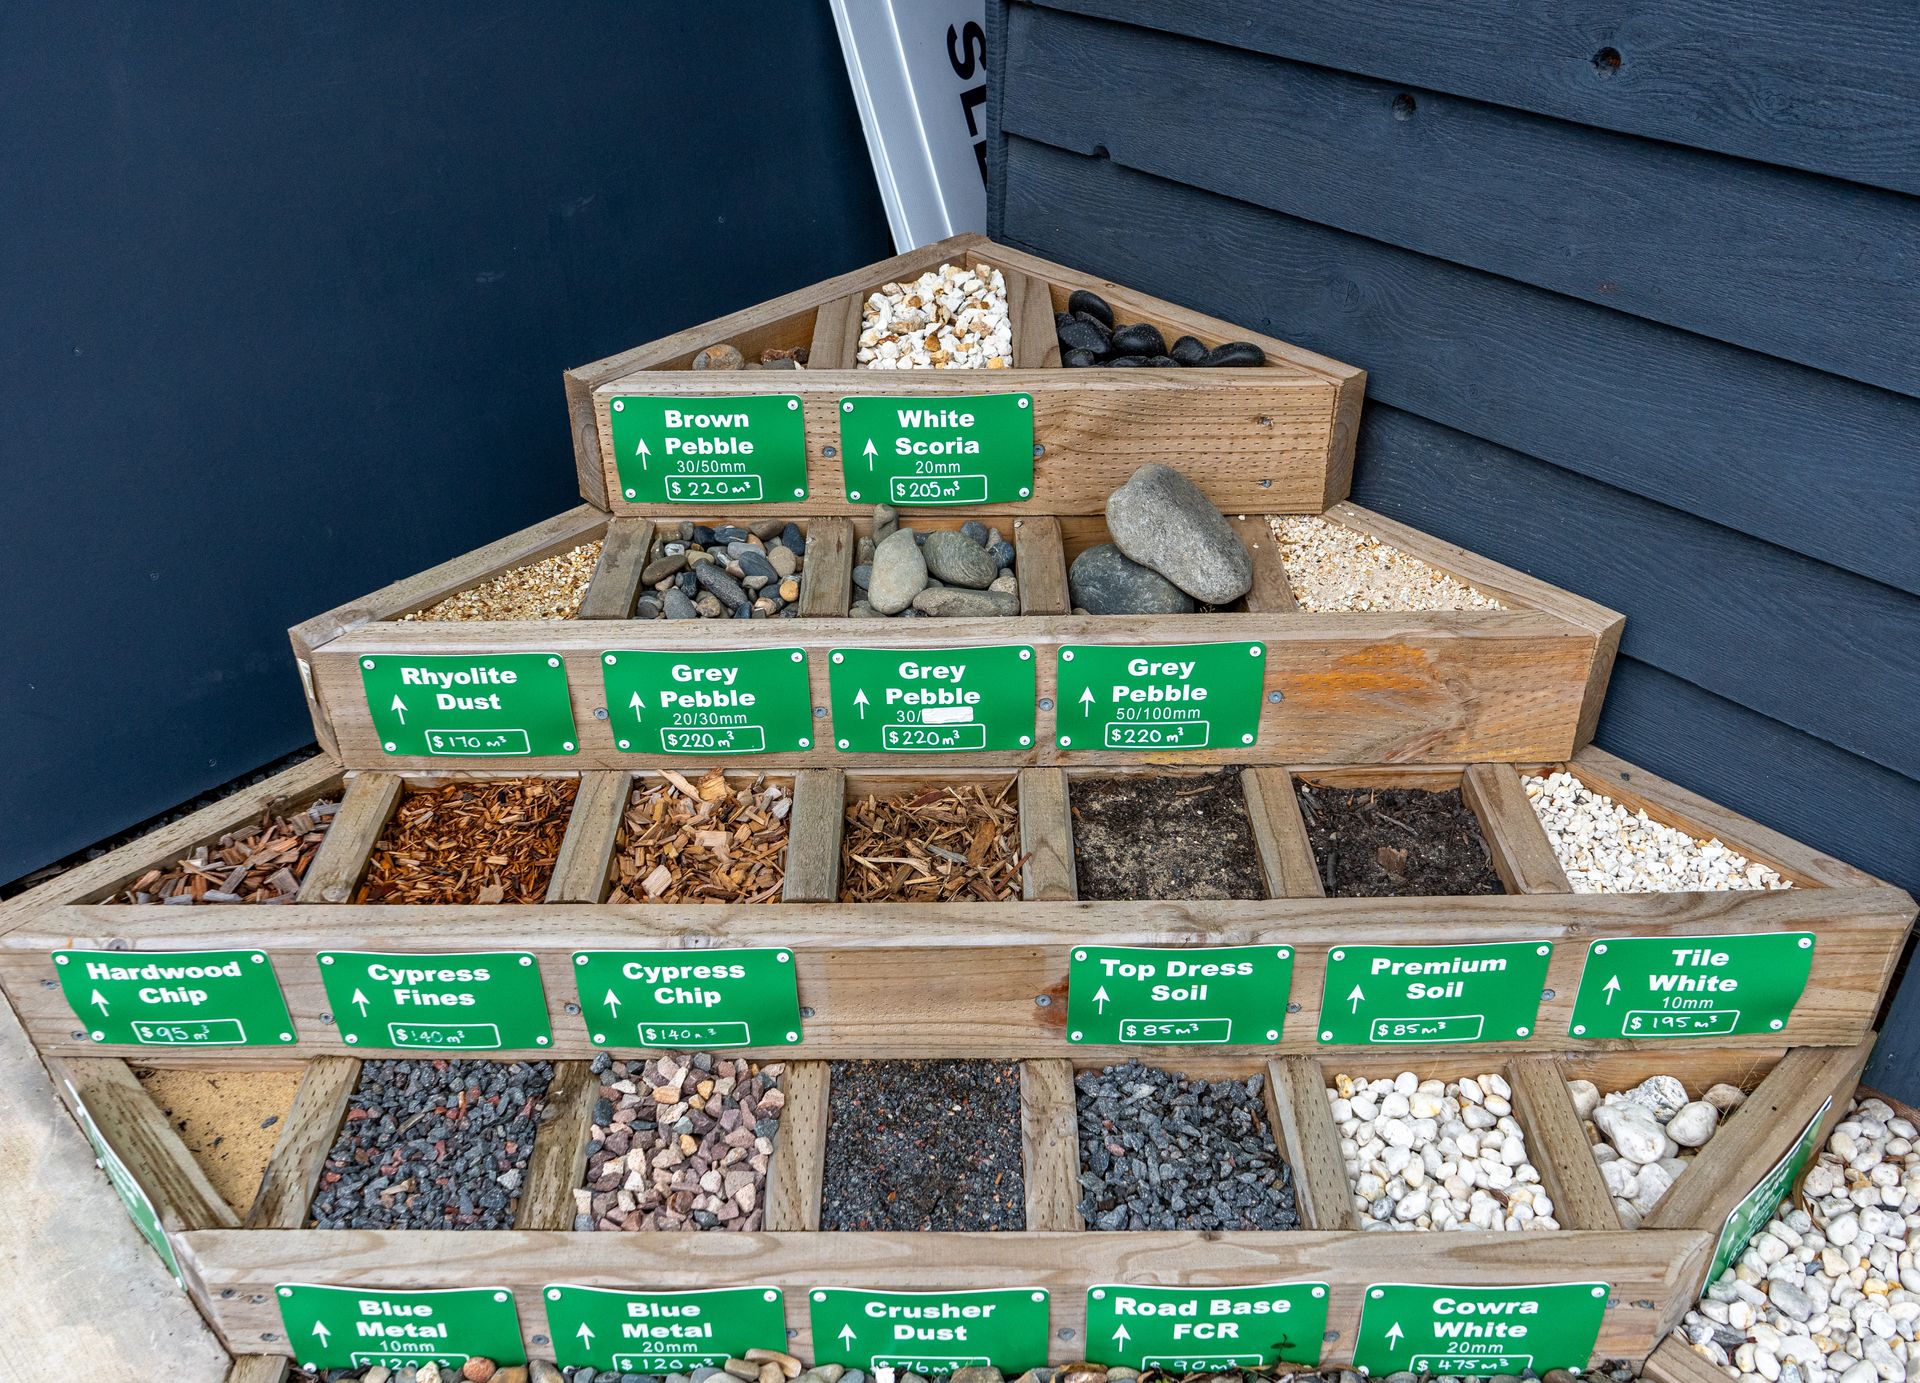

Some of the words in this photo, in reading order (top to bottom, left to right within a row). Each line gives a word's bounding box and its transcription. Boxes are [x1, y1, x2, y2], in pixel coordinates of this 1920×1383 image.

[665, 410, 749, 428] Brown
[897, 410, 974, 427] White
[665, 437, 753, 454] Pebble
[896, 437, 979, 455] Scoria
[677, 460, 745, 472] 30/50mm
[916, 461, 960, 473] 20mm
[672, 665, 738, 685] Grey
[899, 662, 965, 683] Grey
[1128, 659, 1195, 679] Grey
[401, 668, 517, 689] Rhyolite
[660, 690, 755, 707] Pebble
[886, 688, 980, 705] Pebble
[1113, 684, 1207, 702] Pebble
[436, 694, 501, 710] Dust
[673, 713, 747, 725] 20/30mm
[1117, 707, 1200, 719] 50/100mm
[1672, 949, 1729, 966] Tile
[86, 961, 242, 980] Hardwood
[368, 964, 490, 984] Cypress
[623, 963, 745, 983] Cypress
[1100, 959, 1157, 981] Top
[1167, 961, 1253, 976] Dress
[1371, 958, 1506, 975] Premium
[1407, 982, 1463, 999] Soil
[1650, 975, 1737, 991] White
[139, 987, 207, 1005] Chip
[394, 989, 475, 1005] Fines
[654, 987, 721, 1007] Chip
[1151, 985, 1207, 1001] Soil
[1663, 997, 1713, 1008] 10mm
[359, 1300, 432, 1316] Blue
[627, 1303, 700, 1317] Blue
[865, 1302, 995, 1318] Crusher
[1115, 1297, 1197, 1316] Road
[1210, 1300, 1290, 1315] Base
[1433, 1298, 1538, 1314] Cowra
[356, 1322, 447, 1337] Metal
[622, 1323, 712, 1338] Metal
[894, 1325, 967, 1340] Dust
[1174, 1323, 1238, 1339] FCR
[1434, 1322, 1527, 1337] White
[379, 1341, 435, 1352] 10mm
[643, 1342, 697, 1352] 20mm
[1447, 1342, 1503, 1353] 20mm
